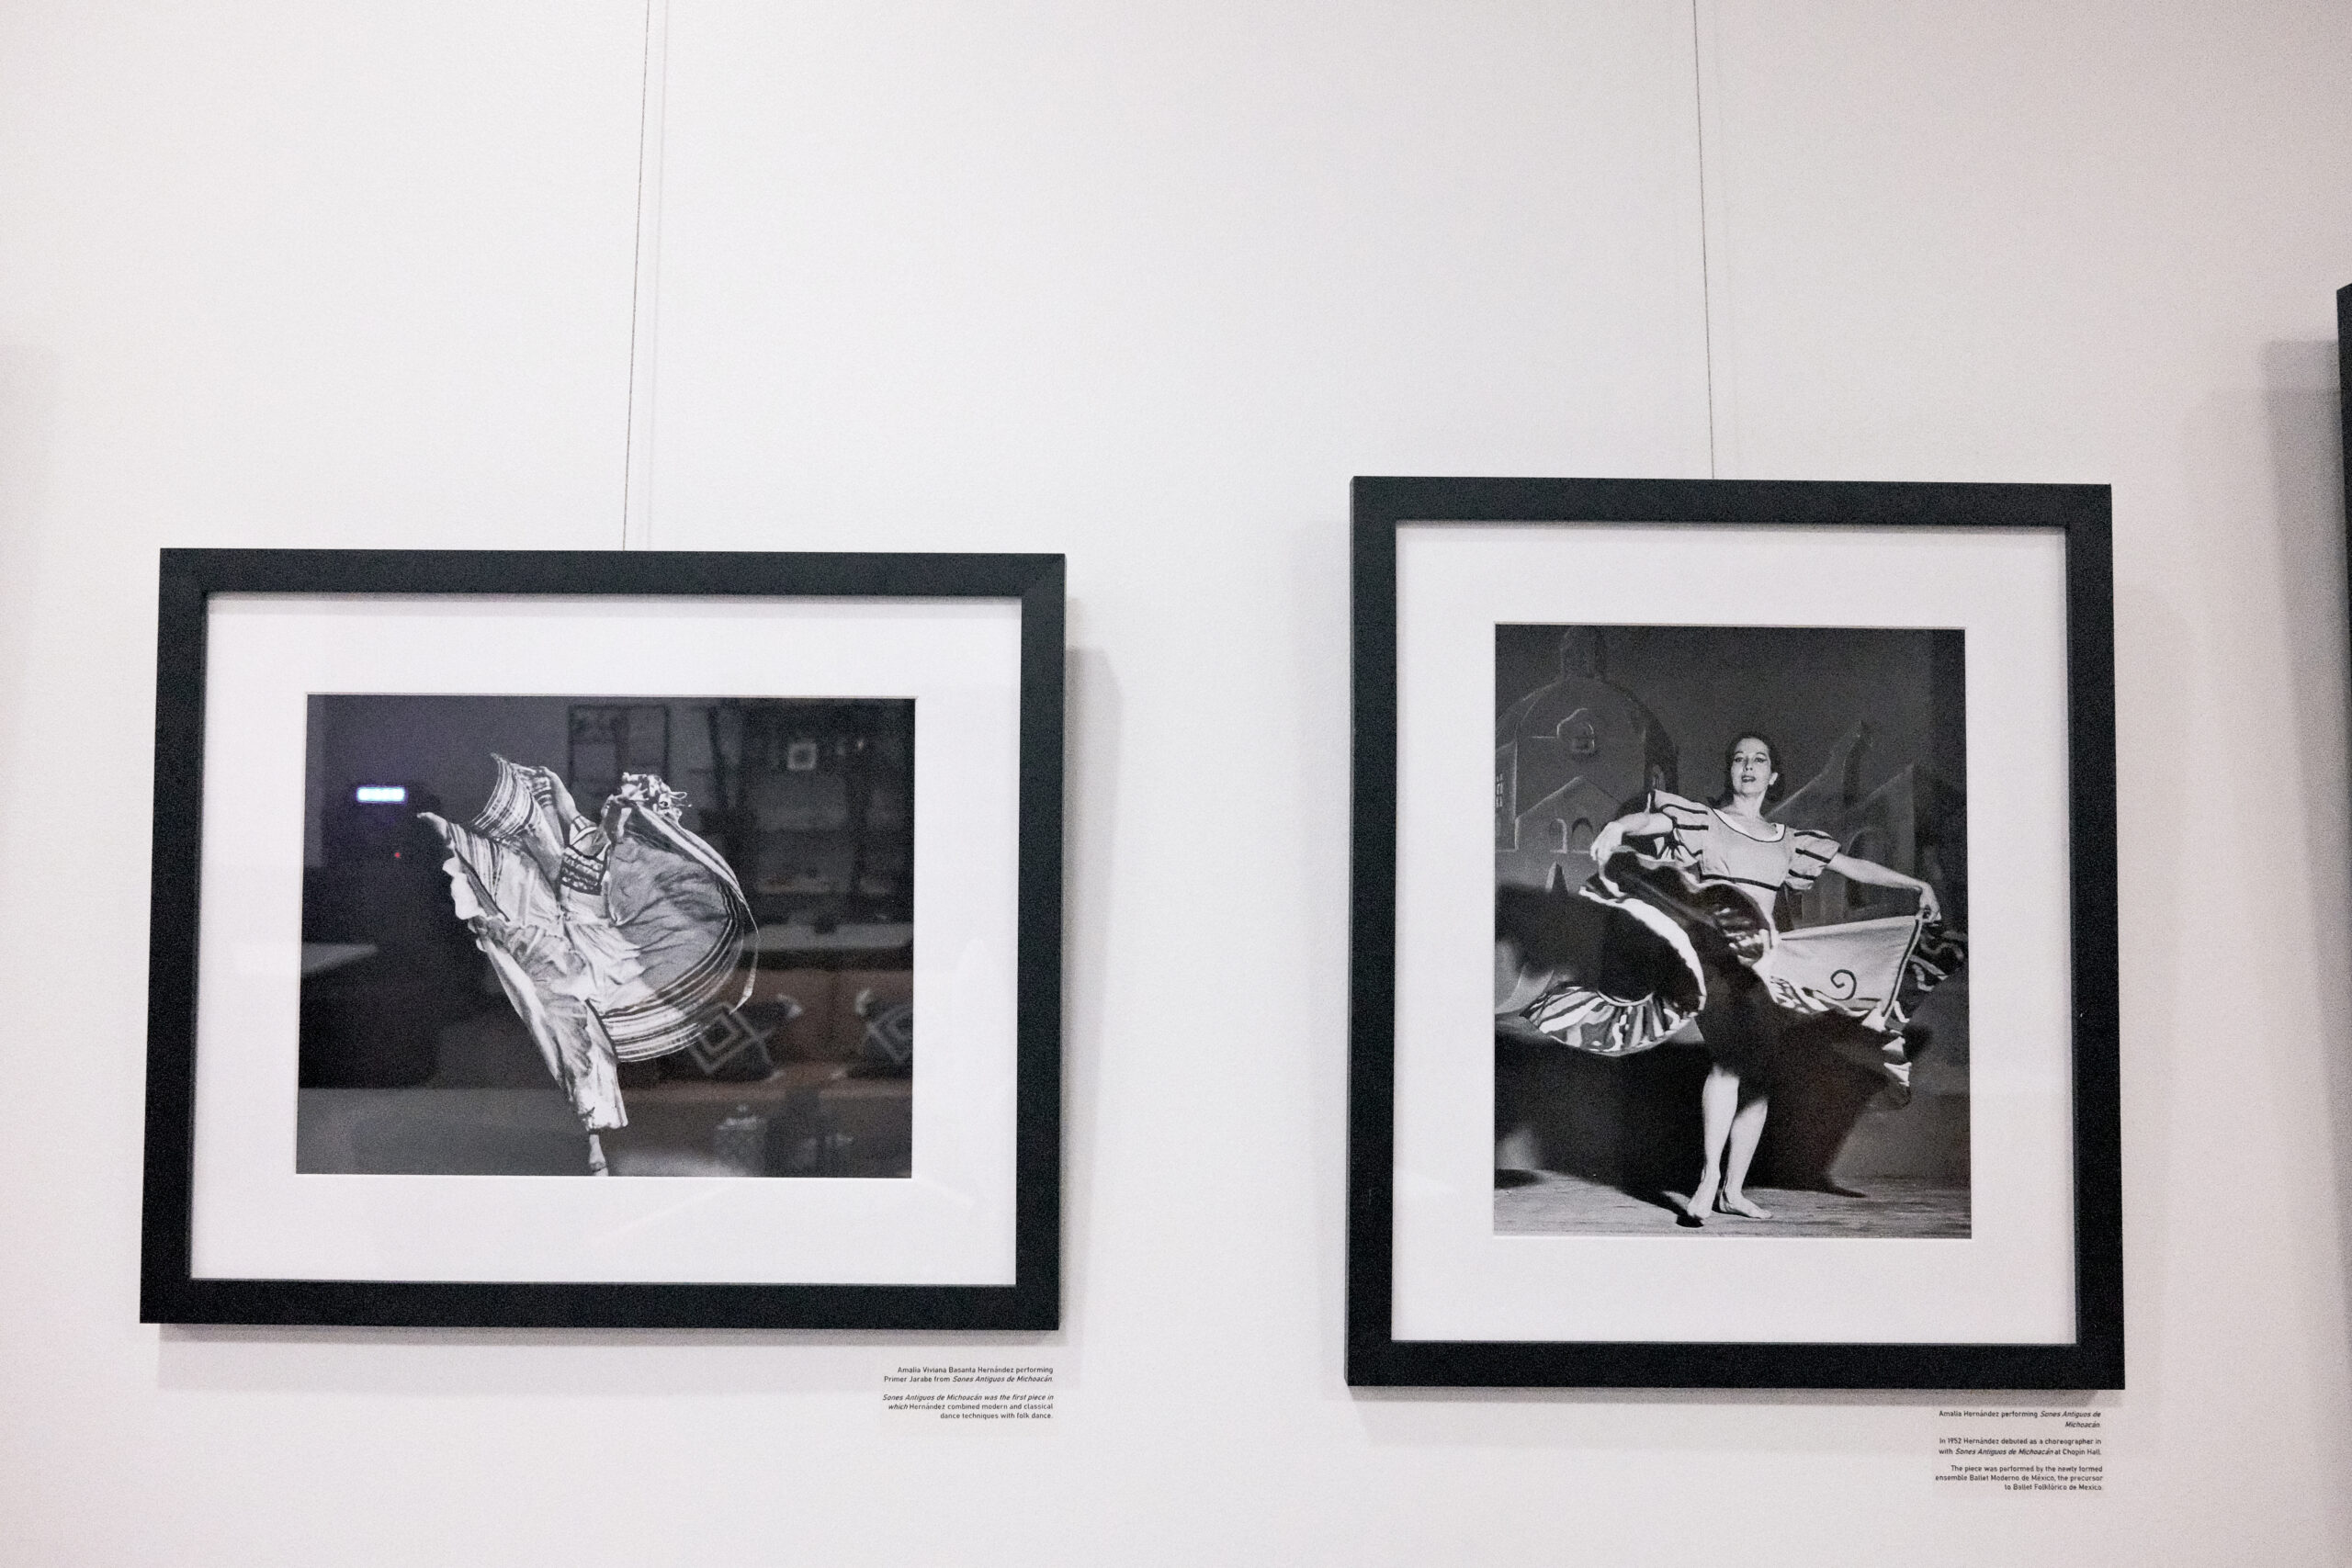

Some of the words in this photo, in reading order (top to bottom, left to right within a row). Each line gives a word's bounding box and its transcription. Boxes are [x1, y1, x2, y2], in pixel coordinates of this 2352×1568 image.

[1016, 1367, 1054, 1375] performing
[905, 1394, 934, 1403] Antiguos
[1027, 1394, 1046, 1403] piece
[1963, 1437, 1999, 1445] Hernández
[1999, 1465, 2034, 1473] performed
